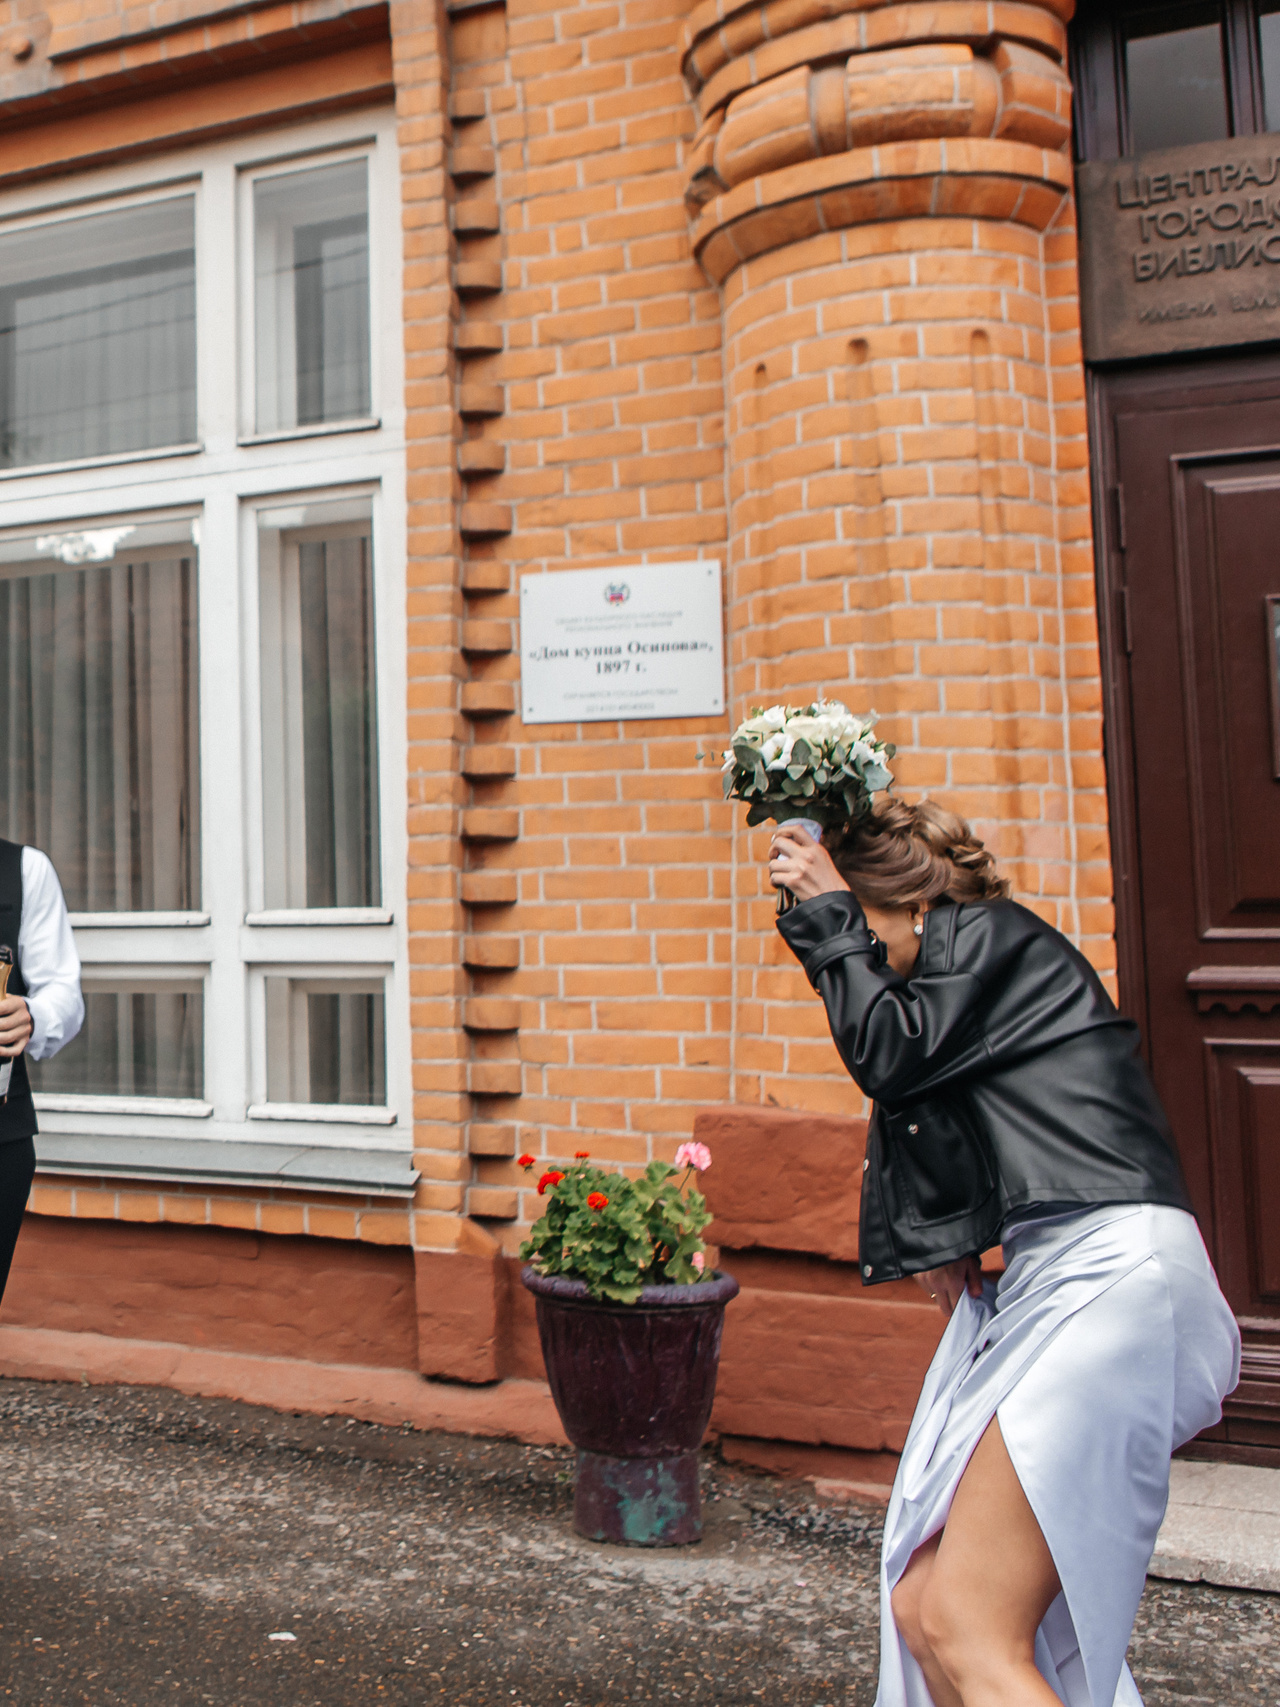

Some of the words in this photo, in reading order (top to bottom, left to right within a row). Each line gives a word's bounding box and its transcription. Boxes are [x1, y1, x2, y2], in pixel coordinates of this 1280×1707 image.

[529, 645, 570, 662] «Дом
[574, 646, 622, 661] купца
[596, 659, 631, 675] 1897
[635, 662, 648, 673] г.
